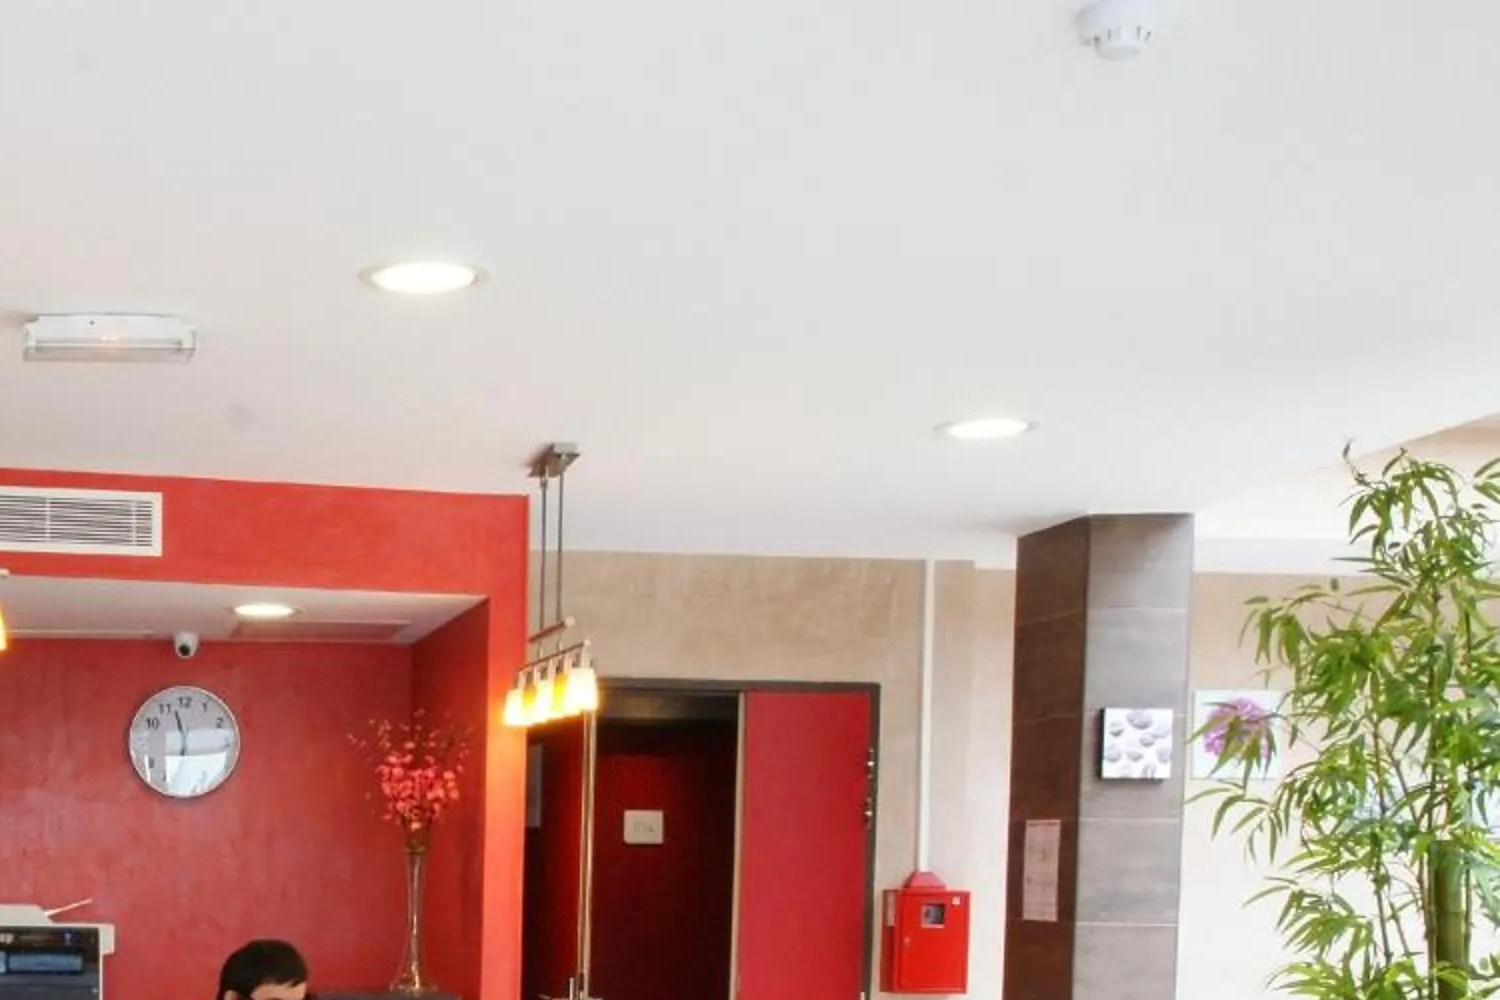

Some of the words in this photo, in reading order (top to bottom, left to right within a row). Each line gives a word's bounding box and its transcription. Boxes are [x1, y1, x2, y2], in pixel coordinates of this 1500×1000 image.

[179, 696, 192, 708] 12
[159, 703, 171, 714] 11
[146, 717, 160, 730] 10
